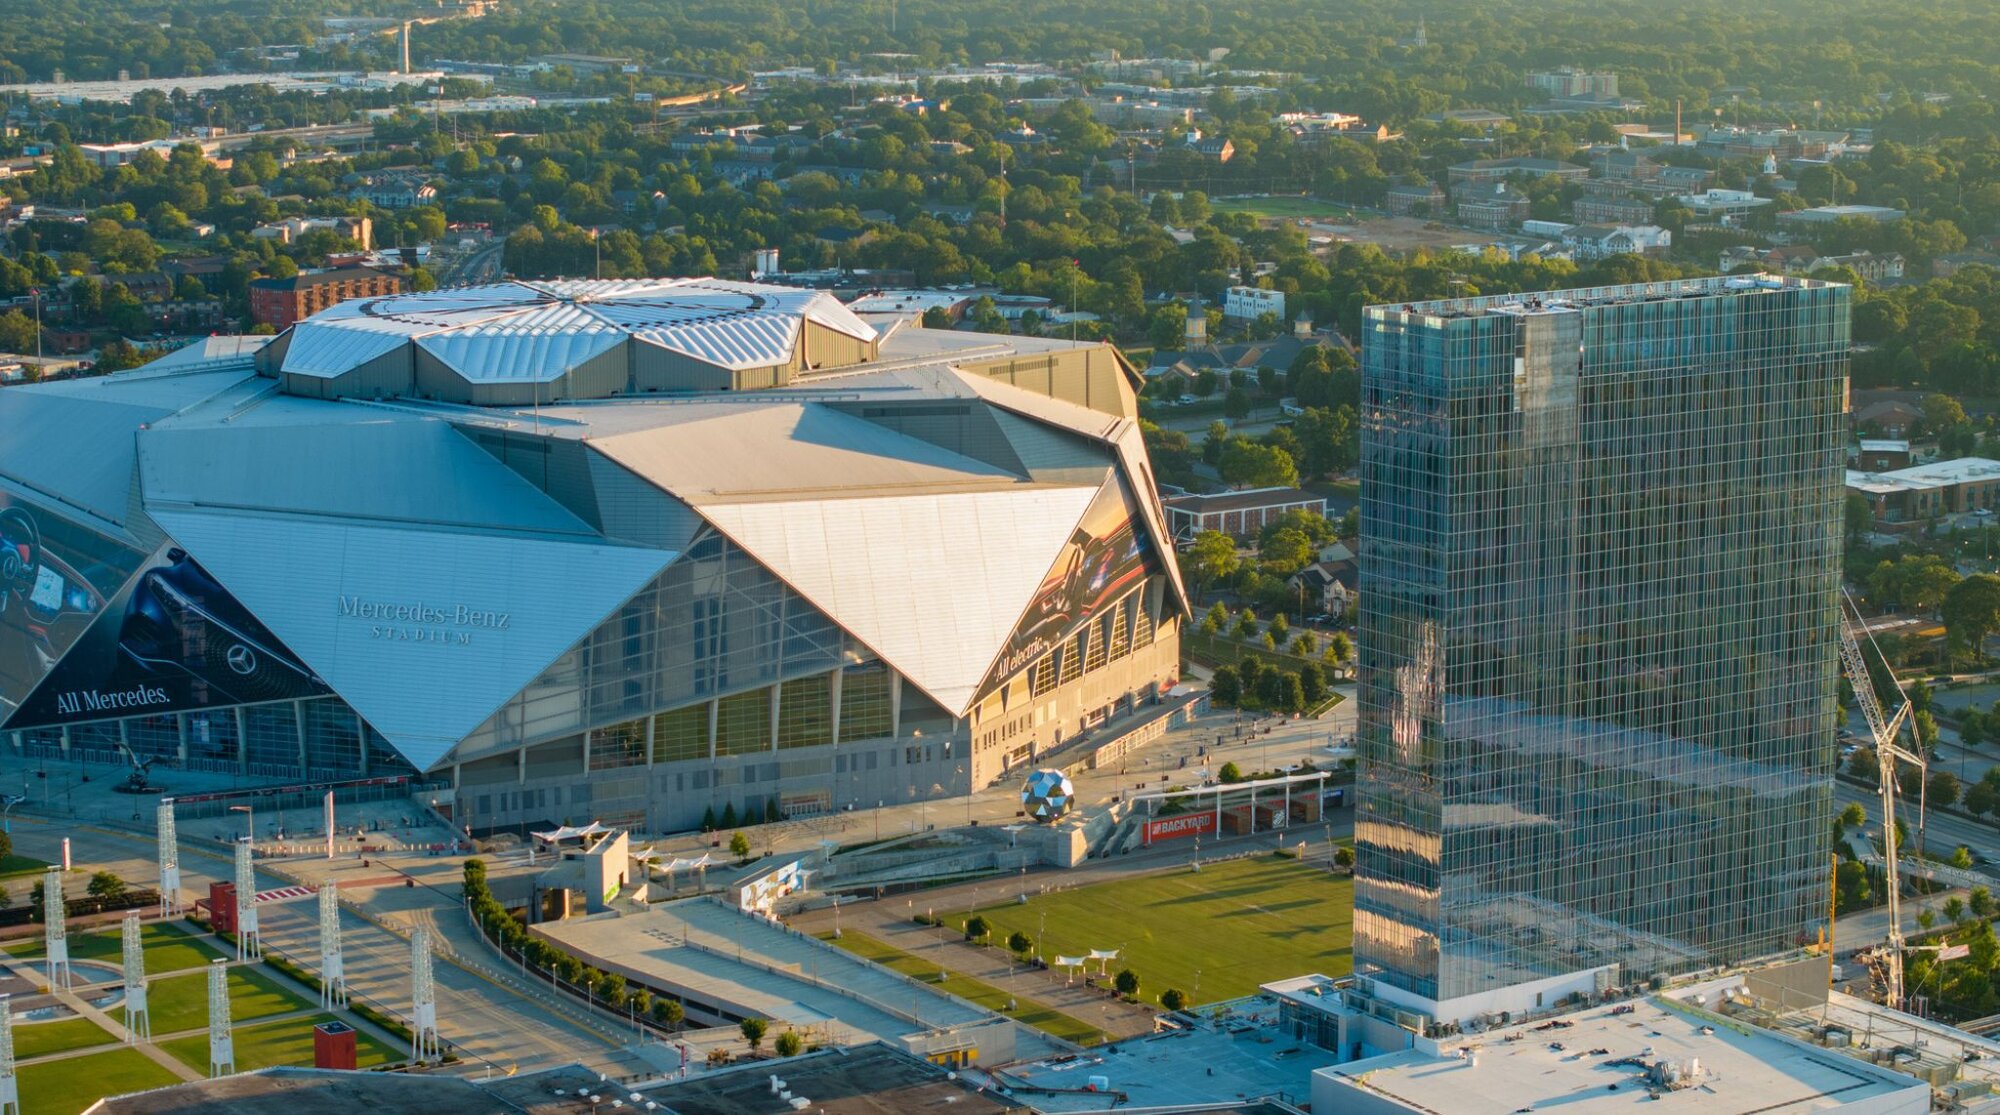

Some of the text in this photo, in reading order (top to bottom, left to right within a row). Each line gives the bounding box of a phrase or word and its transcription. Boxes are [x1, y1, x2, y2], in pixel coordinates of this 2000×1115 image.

[338, 595, 510, 630] Mercedes-Benz
[372, 626, 471, 645] STADIUM
[996, 656, 1009, 682] All
[57, 684, 170, 714] All Mercedes.
